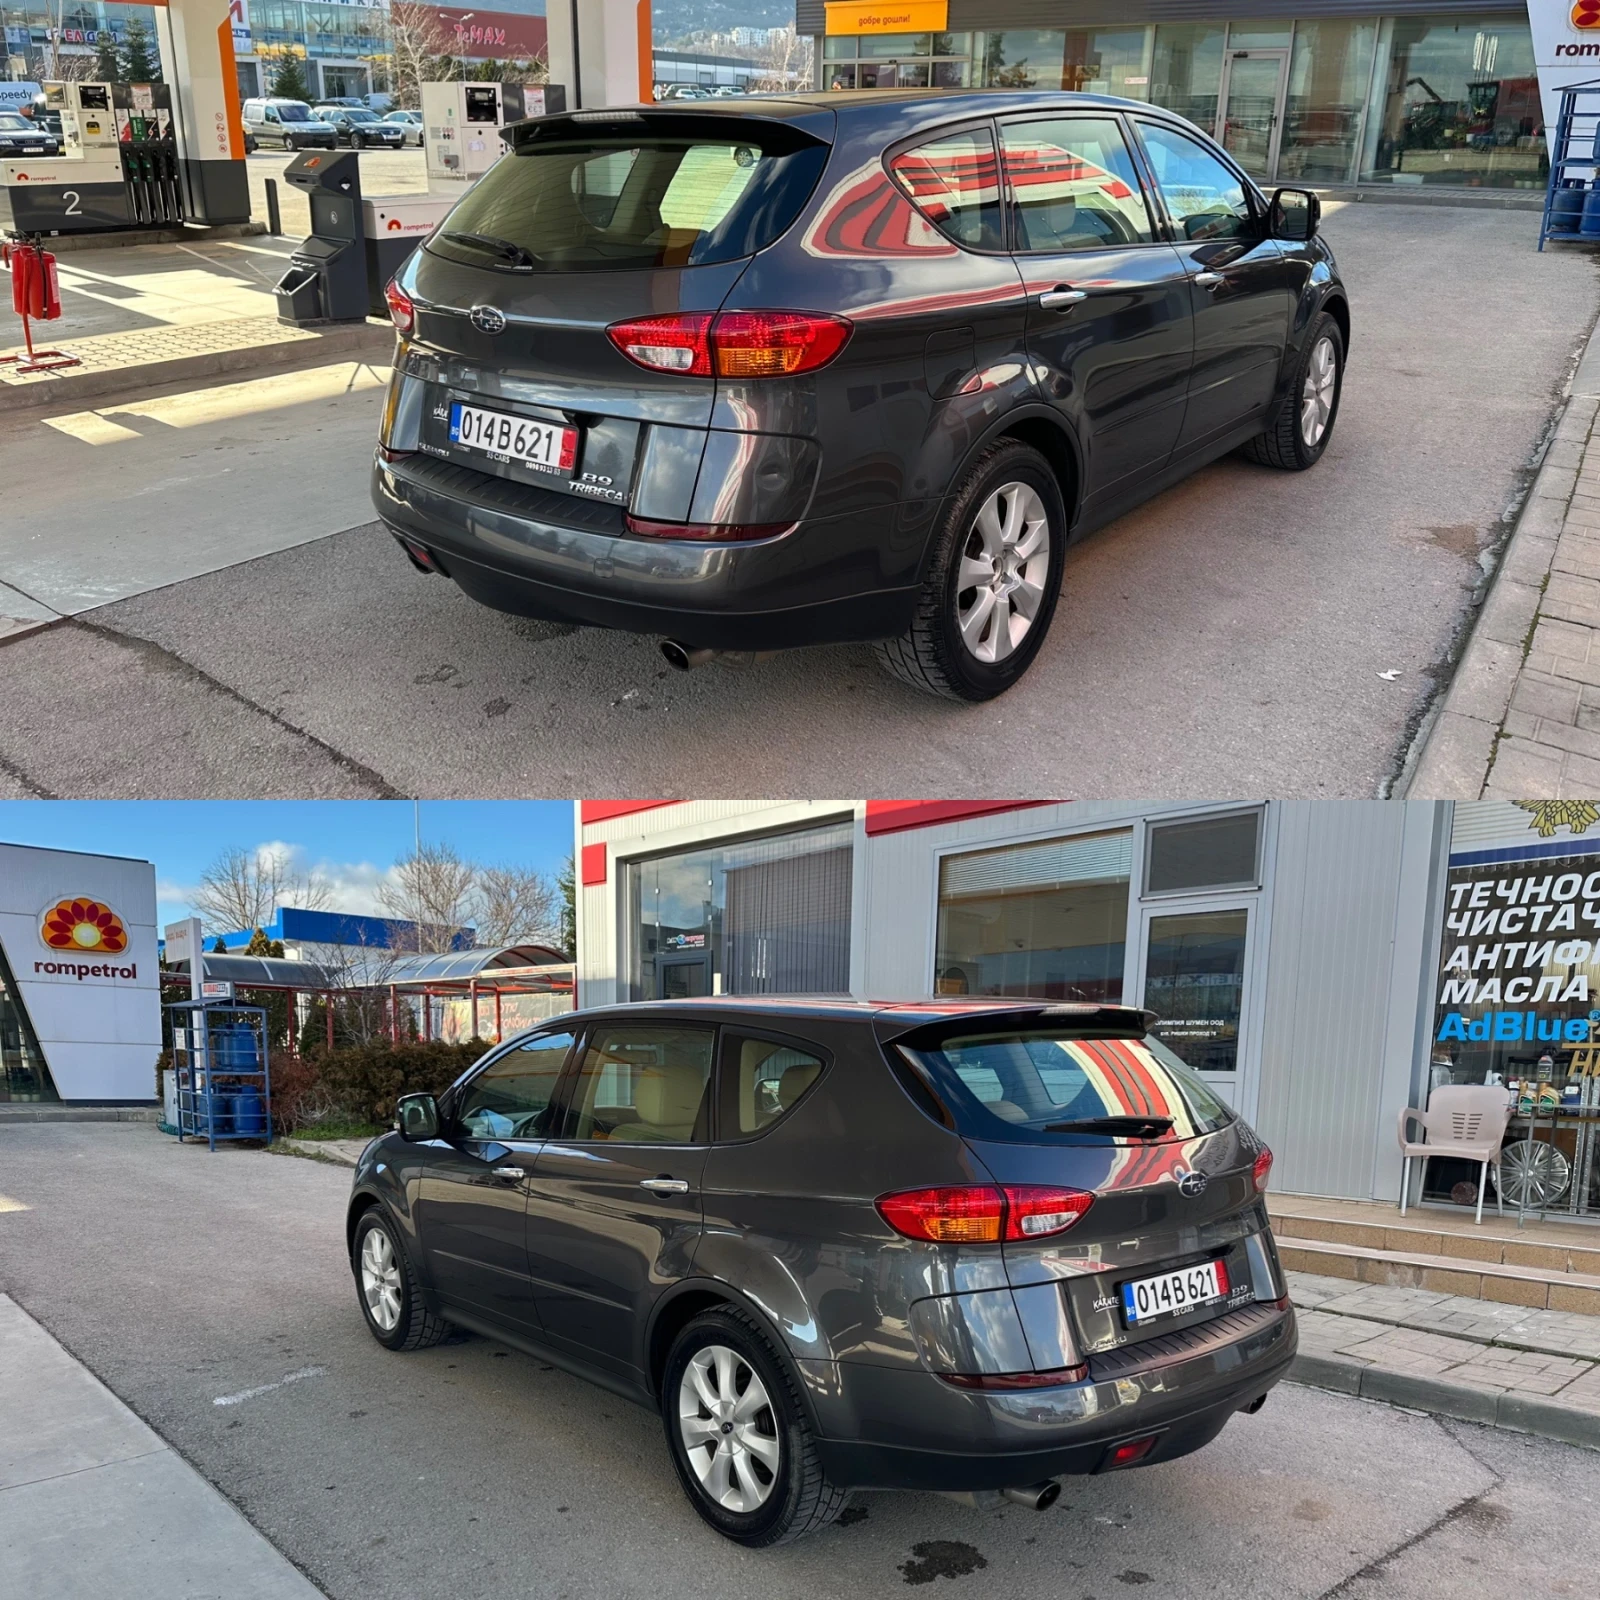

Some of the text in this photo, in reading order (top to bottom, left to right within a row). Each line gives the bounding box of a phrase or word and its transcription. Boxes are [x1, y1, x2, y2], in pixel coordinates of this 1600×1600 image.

[858, 14, 911, 27] добре дошли!
[0, 89, 33, 102] peedy
[62, 190, 83, 216] 2
[568, 481, 625, 502] TRIBECA
[33, 959, 138, 982] rompetrol
[1439, 974, 1589, 1005] МАСЛА
[1126, 1306, 1136, 1317] BG
